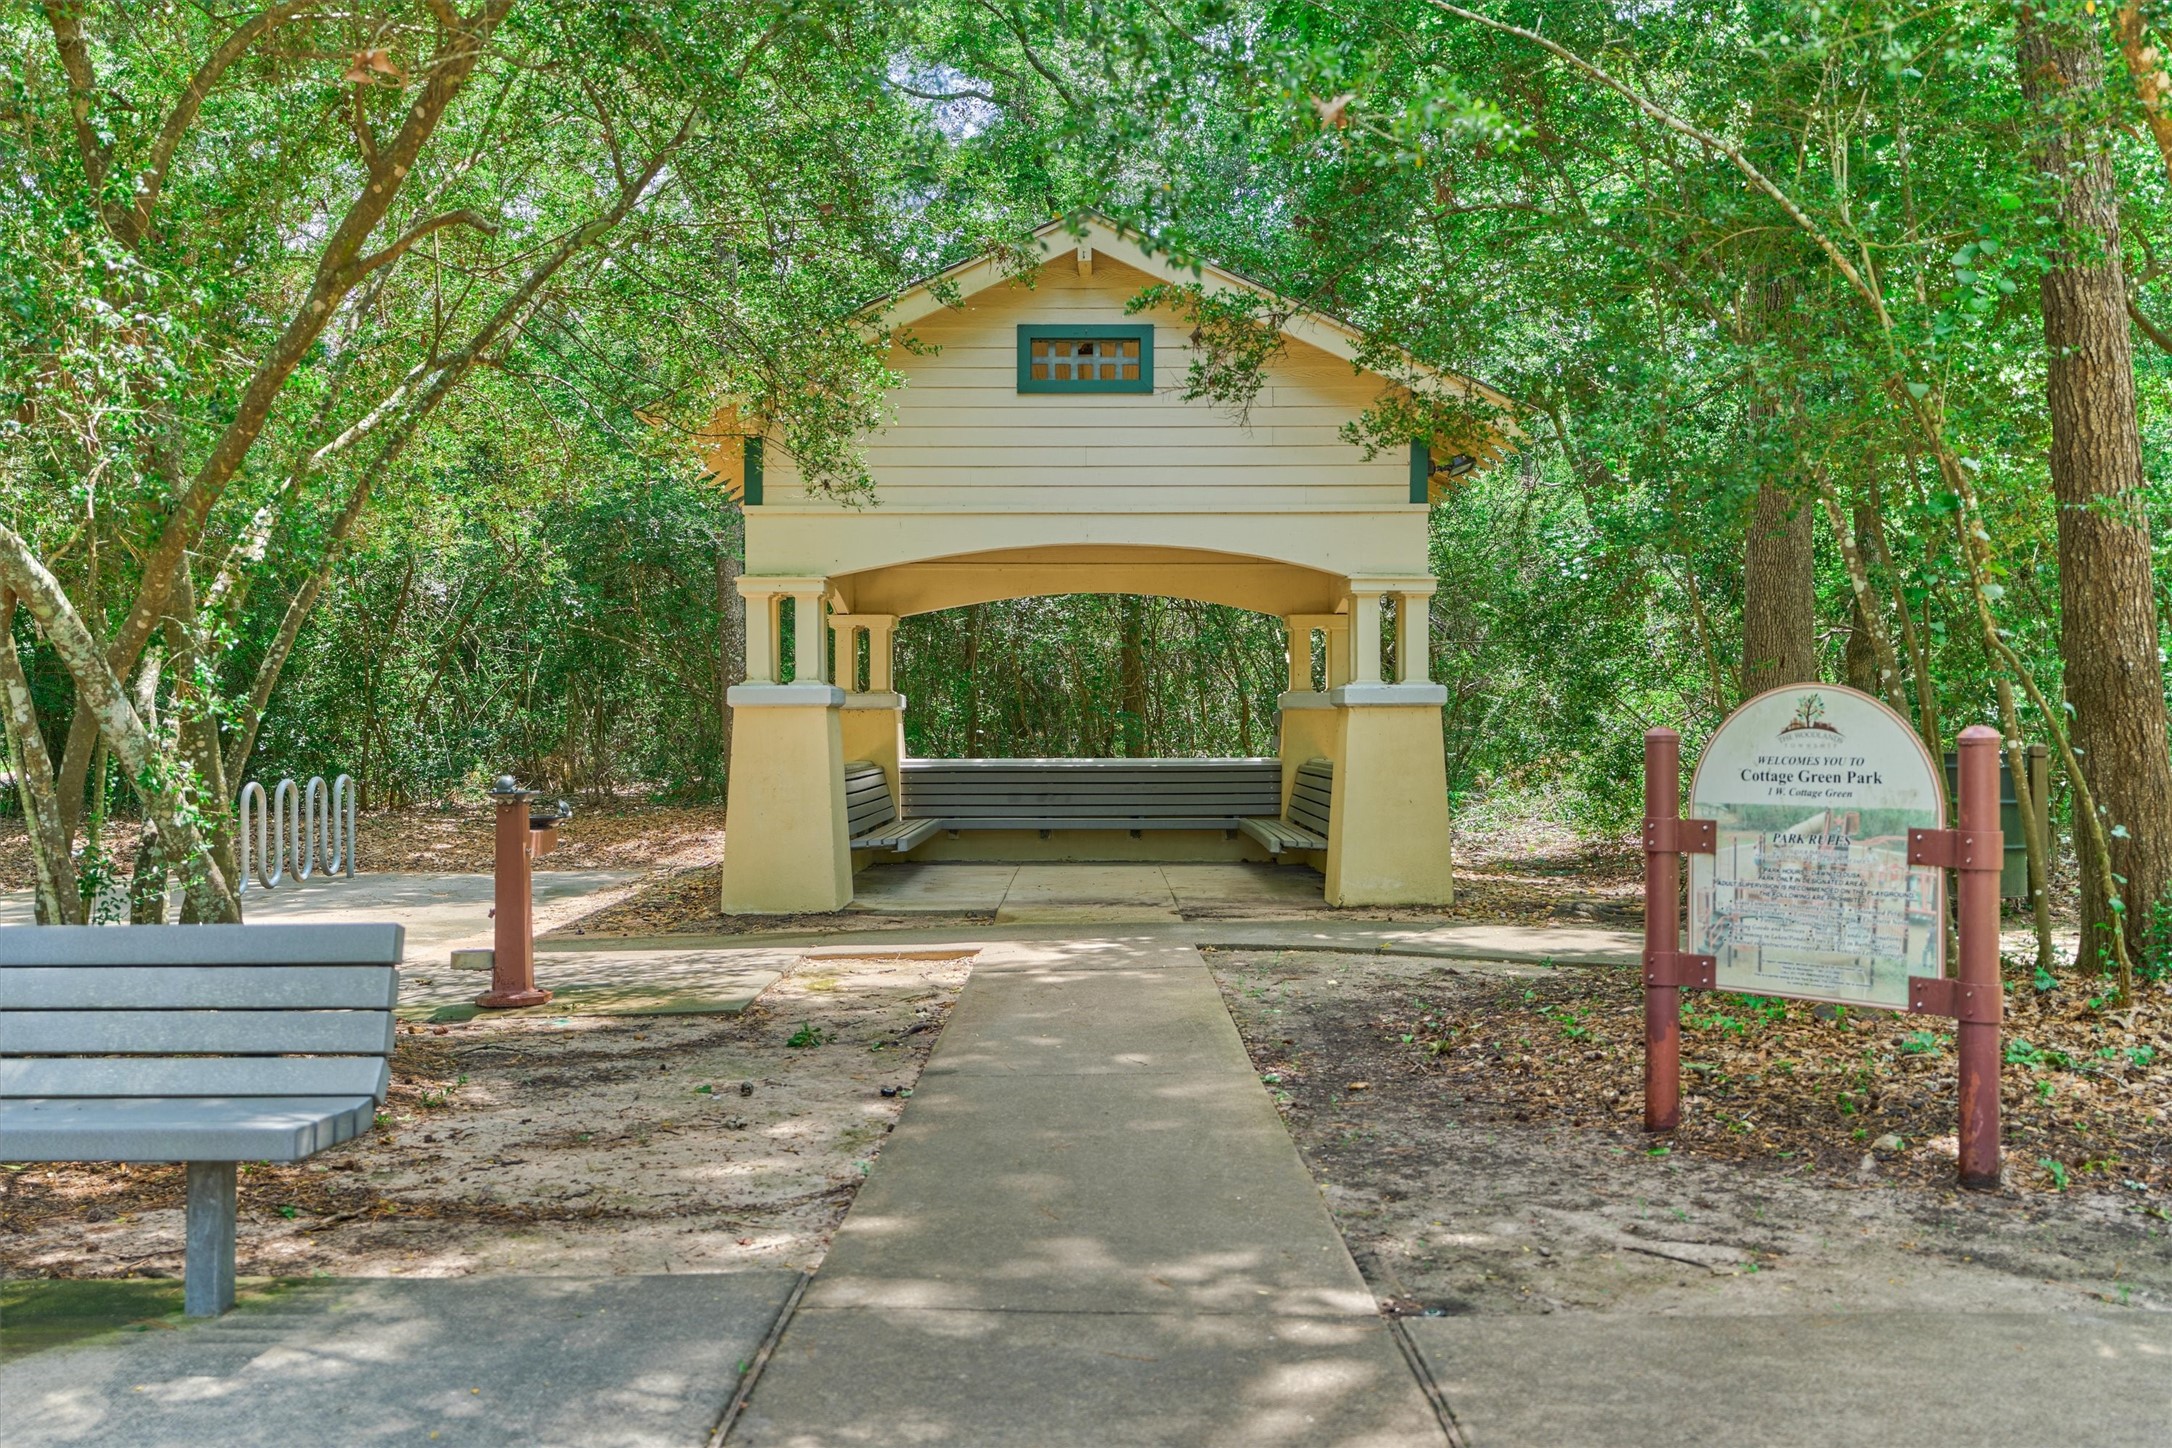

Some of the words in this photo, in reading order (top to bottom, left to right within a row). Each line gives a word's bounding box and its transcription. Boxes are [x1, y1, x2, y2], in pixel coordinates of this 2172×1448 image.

[1779, 733, 1792, 744] THE
[1794, 731, 1844, 744] WOODLANDS
[1758, 755, 1820, 766] WELCOMES
[1823, 756, 1847, 766] YOU
[1850, 757, 1865, 767] TO
[1740, 768, 1794, 785] Cottage
[1798, 769, 1841, 784] Green
[1847, 770, 1883, 784] Park
[1775, 787, 1786, 796] W.
[1789, 788, 1823, 799] Cottage
[1825, 788, 1853, 798] Green
[1773, 833, 1804, 844] PARK
[1738, 881, 1780, 890] SUPERVISION
[1788, 885, 1840, 895] RECOMMENDED
[1772, 892, 1810, 900] FOLLOWING
